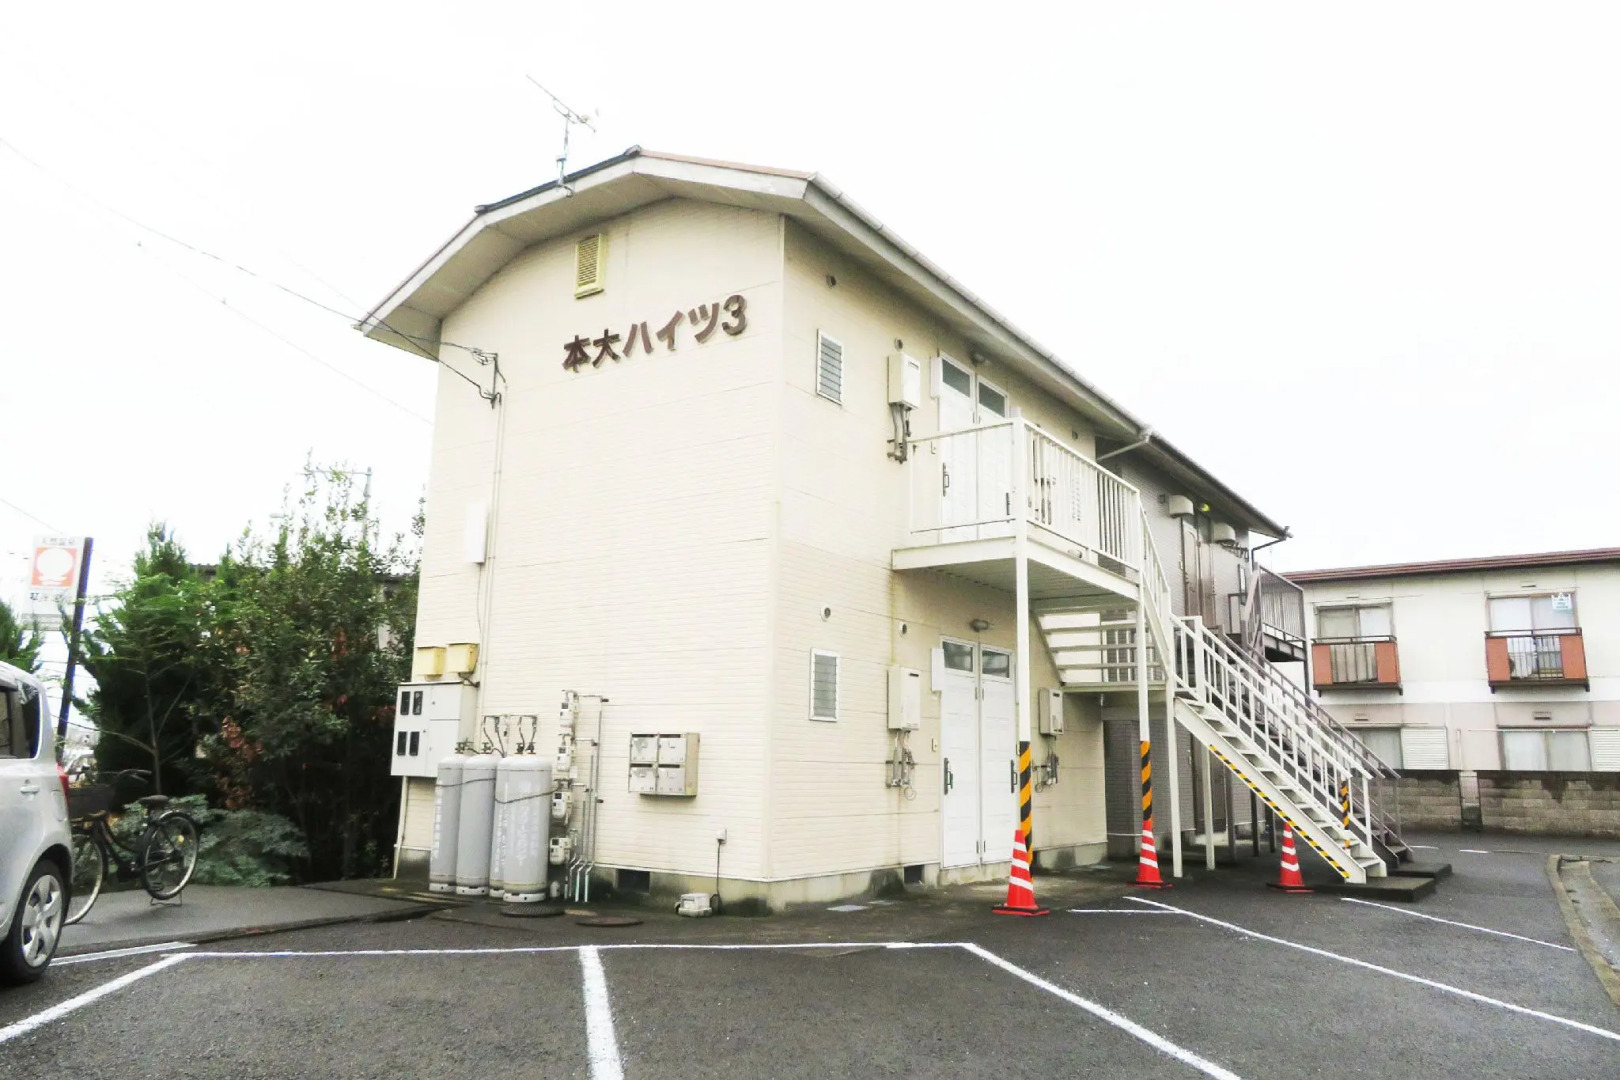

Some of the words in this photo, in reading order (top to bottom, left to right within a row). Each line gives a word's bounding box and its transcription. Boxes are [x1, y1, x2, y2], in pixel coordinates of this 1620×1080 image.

[562, 294, 748, 373] 本大ハイツ3
